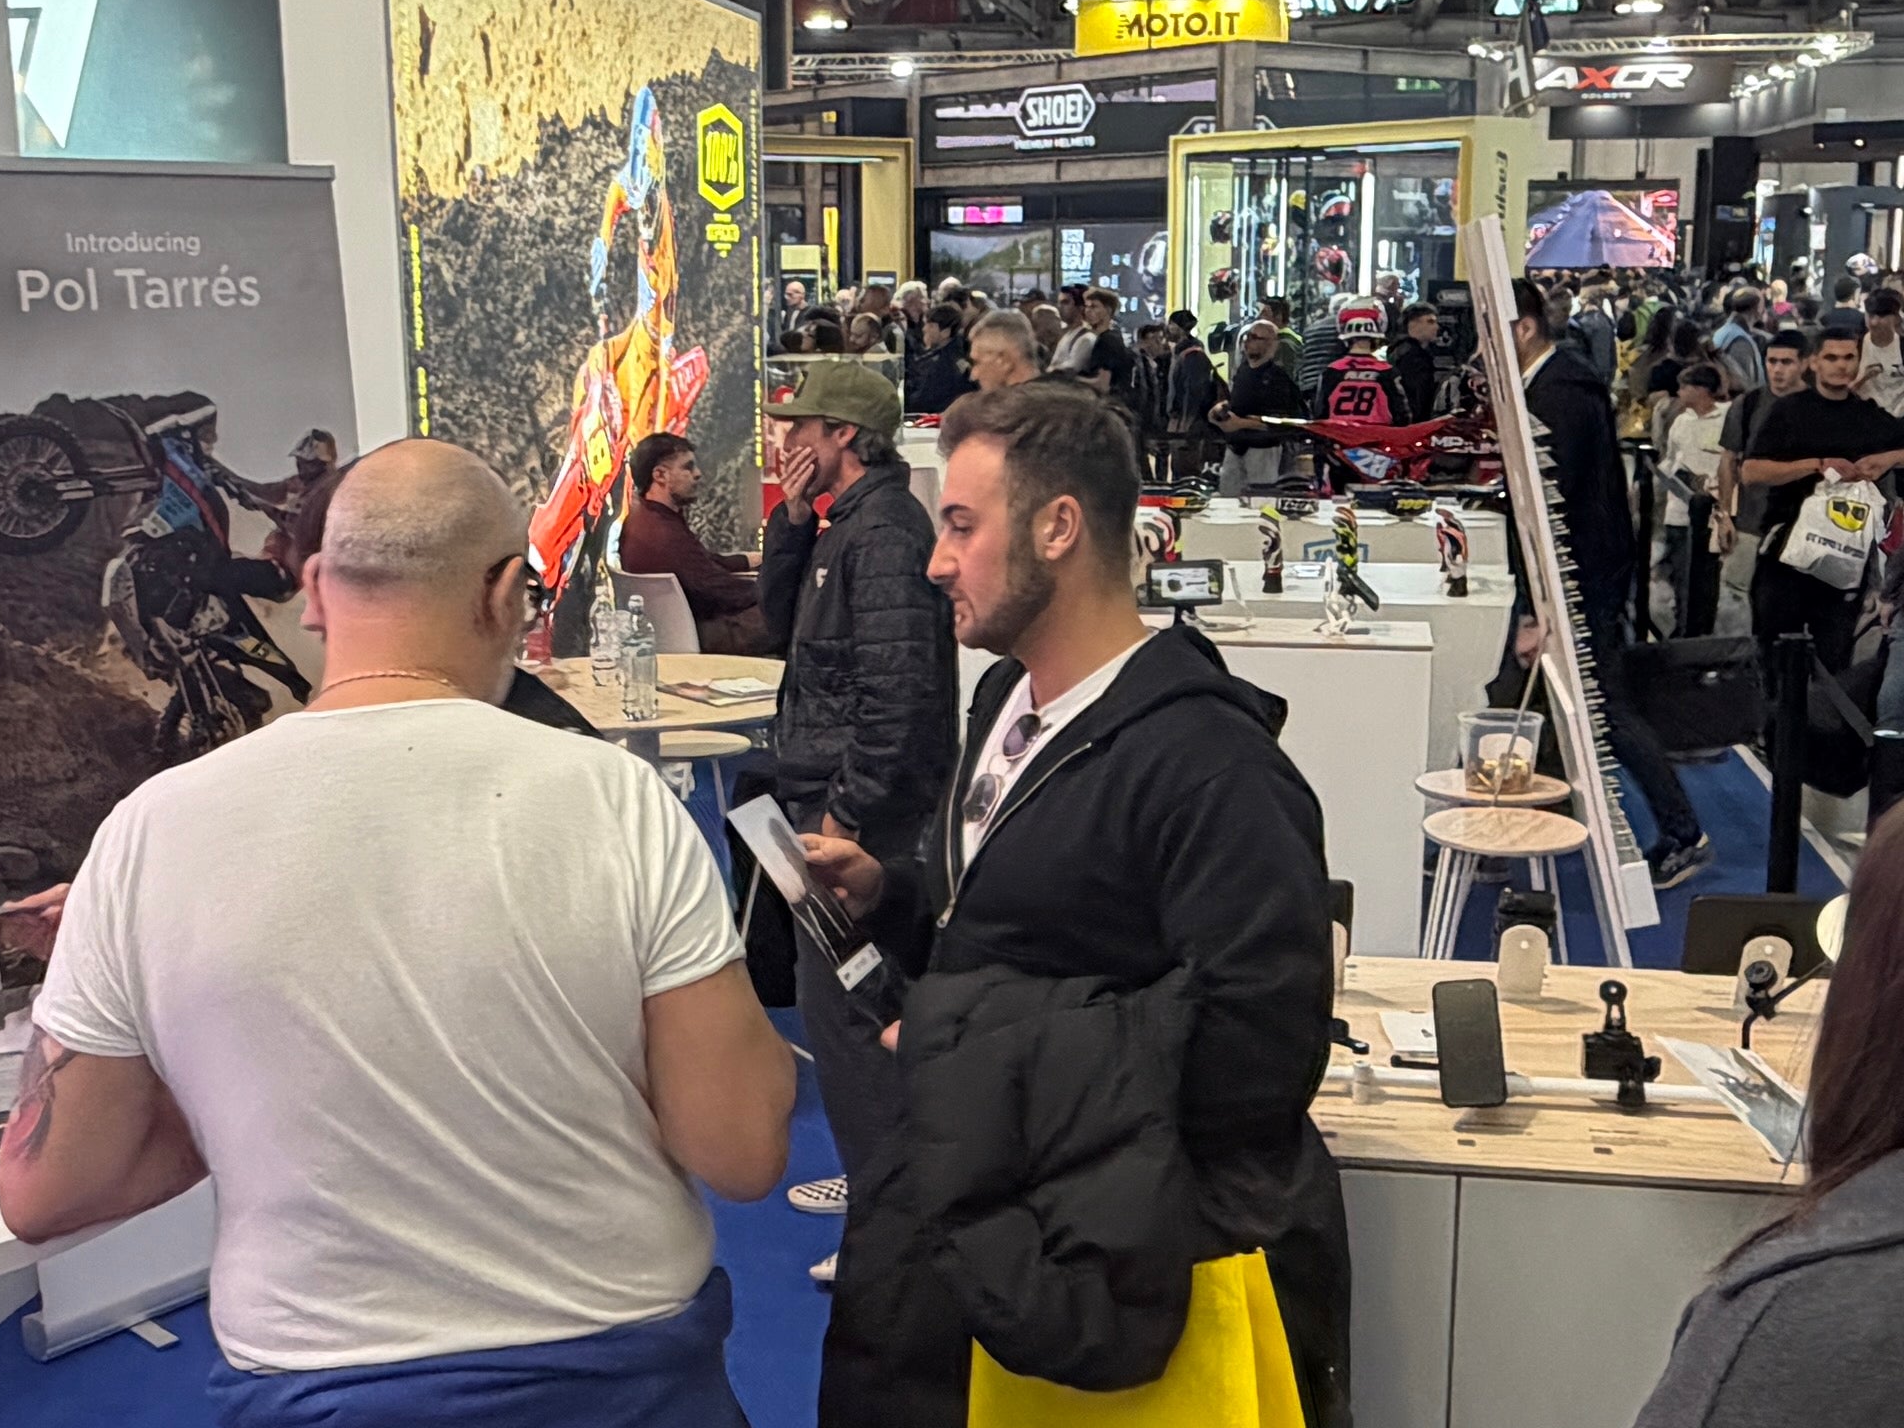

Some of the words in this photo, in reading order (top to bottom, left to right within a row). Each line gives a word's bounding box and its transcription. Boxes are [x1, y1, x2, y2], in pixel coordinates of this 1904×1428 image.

[1115, 10, 1242, 40] MOTO.IT
[1025, 92, 1085, 128] SHOEI
[66, 232, 202, 257] Introducing
[16, 268, 99, 313] Pol
[113, 264, 262, 310] Tarrés
[1333, 386, 1377, 417] 28
